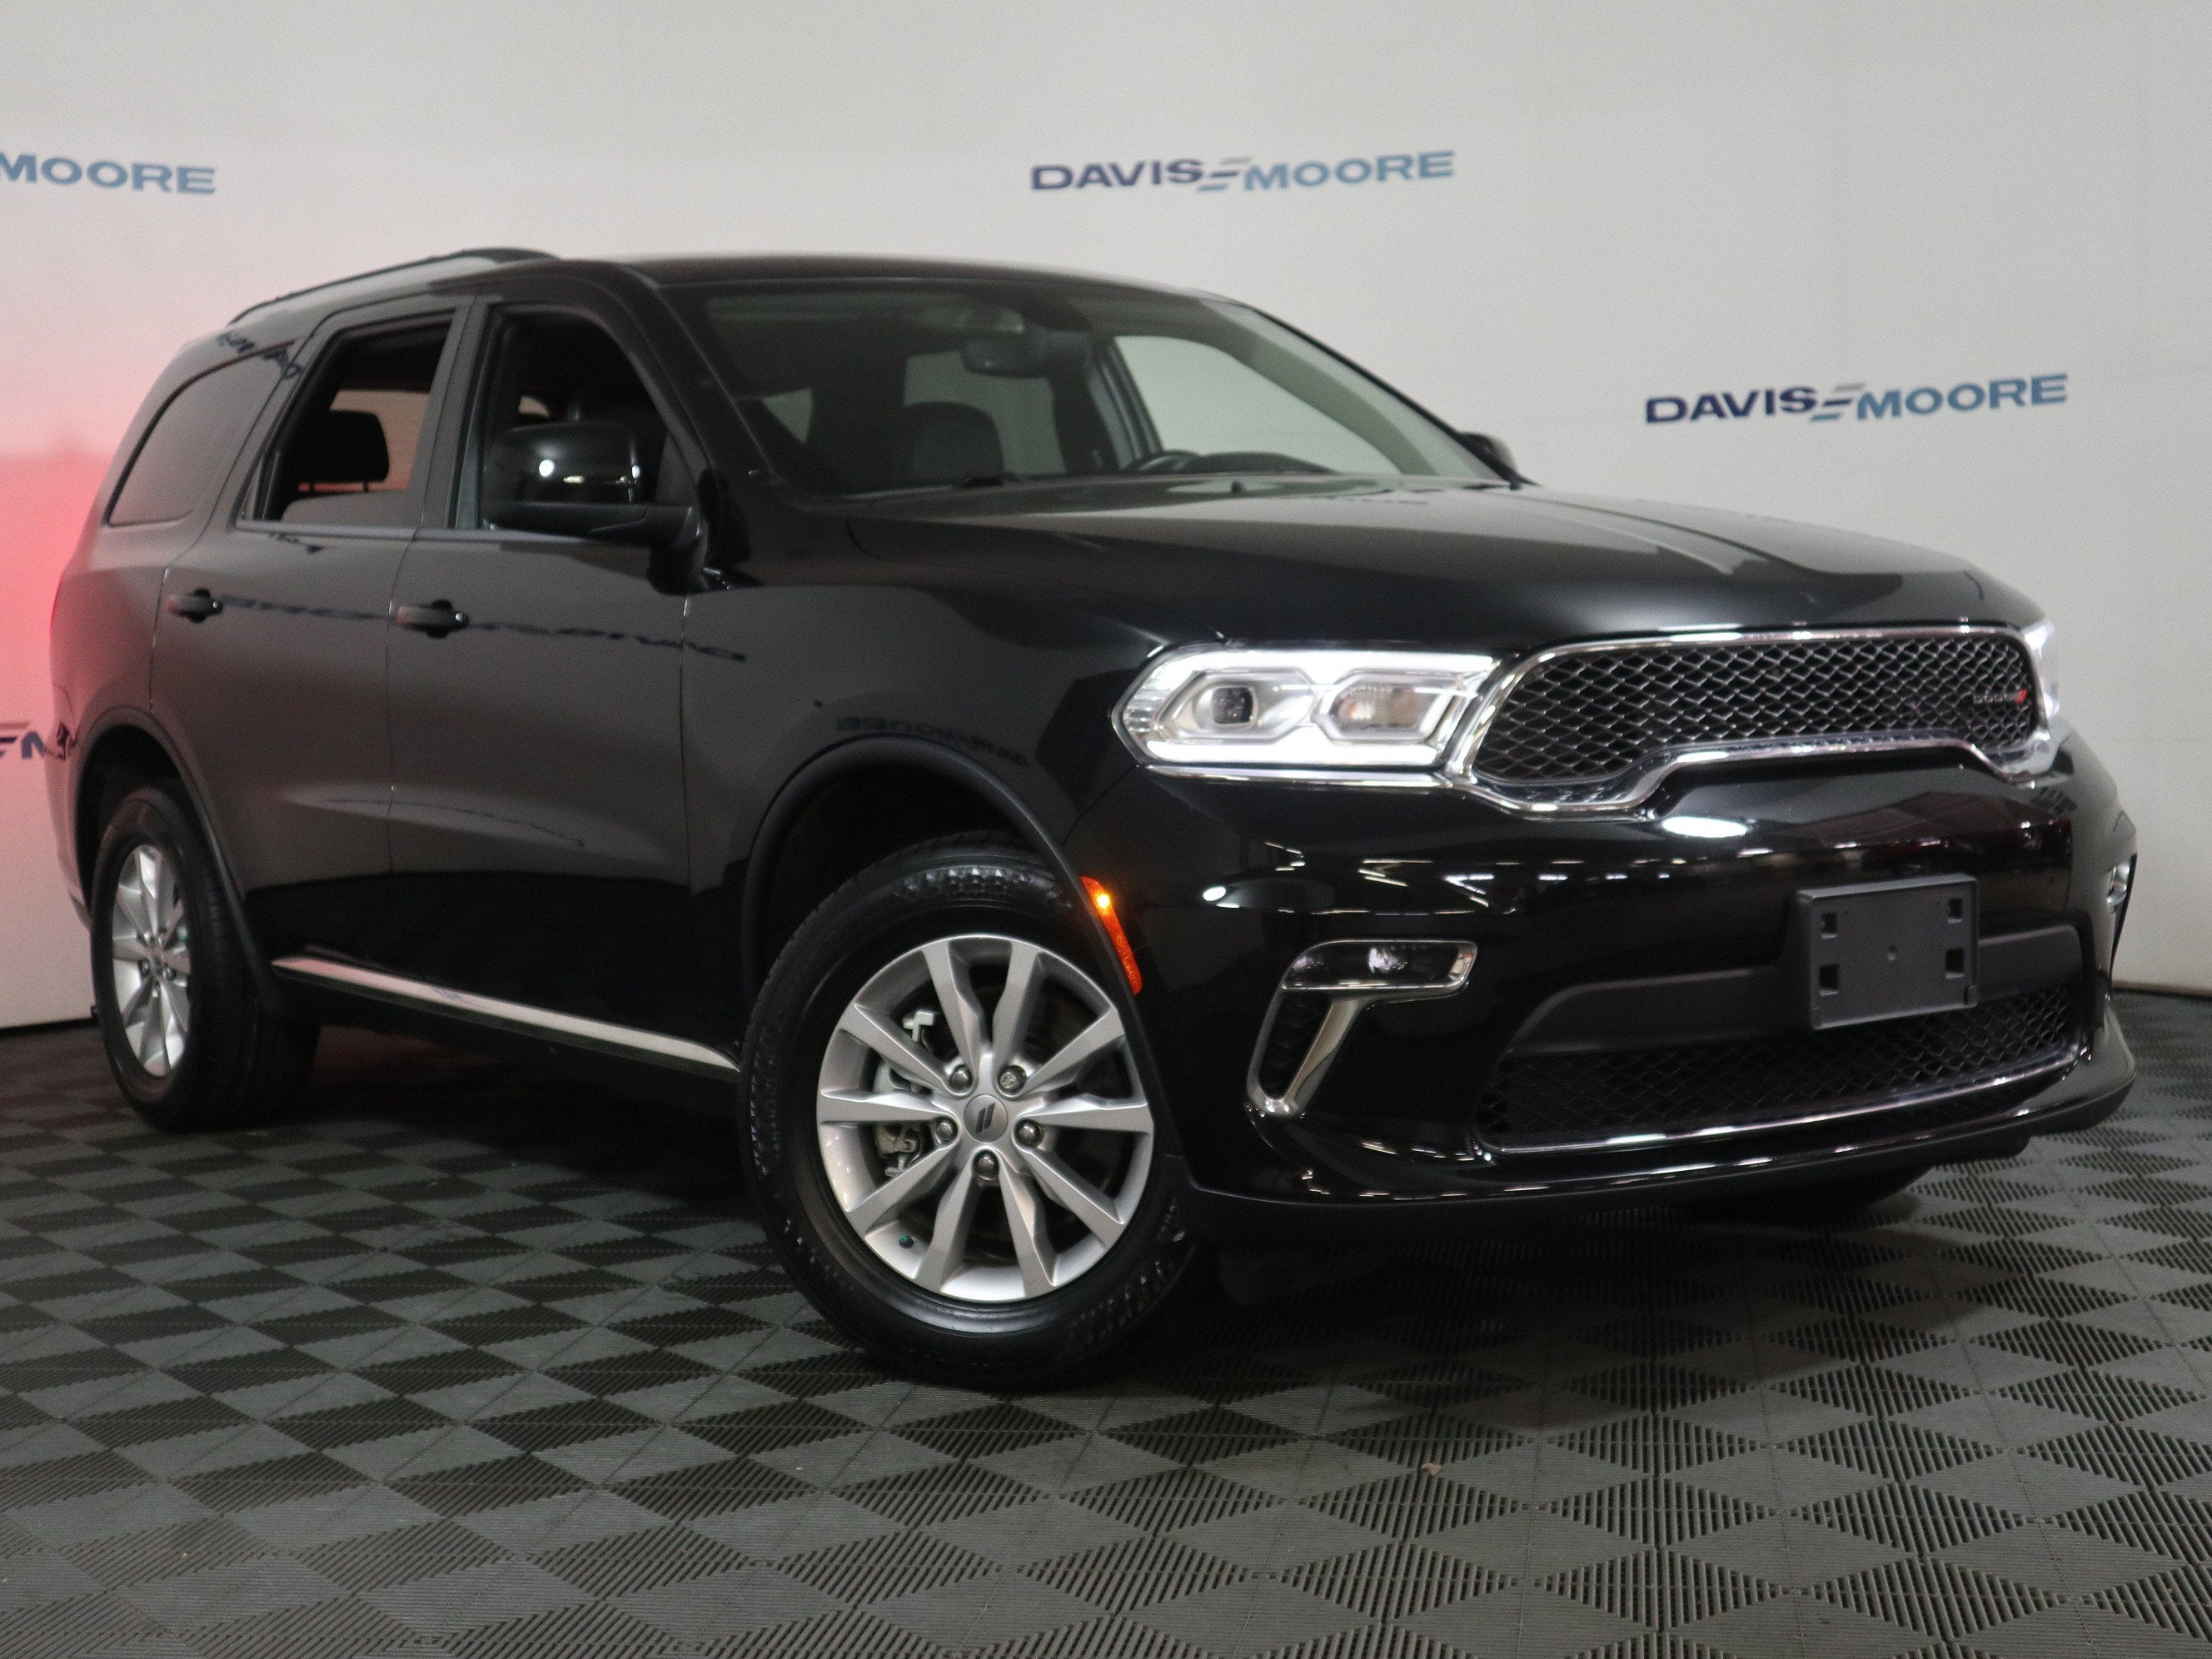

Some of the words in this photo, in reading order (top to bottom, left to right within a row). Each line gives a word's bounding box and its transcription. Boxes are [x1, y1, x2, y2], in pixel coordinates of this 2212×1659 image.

[0, 152, 215, 194] MOORE
[1030, 157, 1204, 191] DAVIS
[1244, 151, 1454, 191] MOORE
[1645, 386, 1817, 425] DAVIS
[1856, 372, 2068, 421] MOORE
